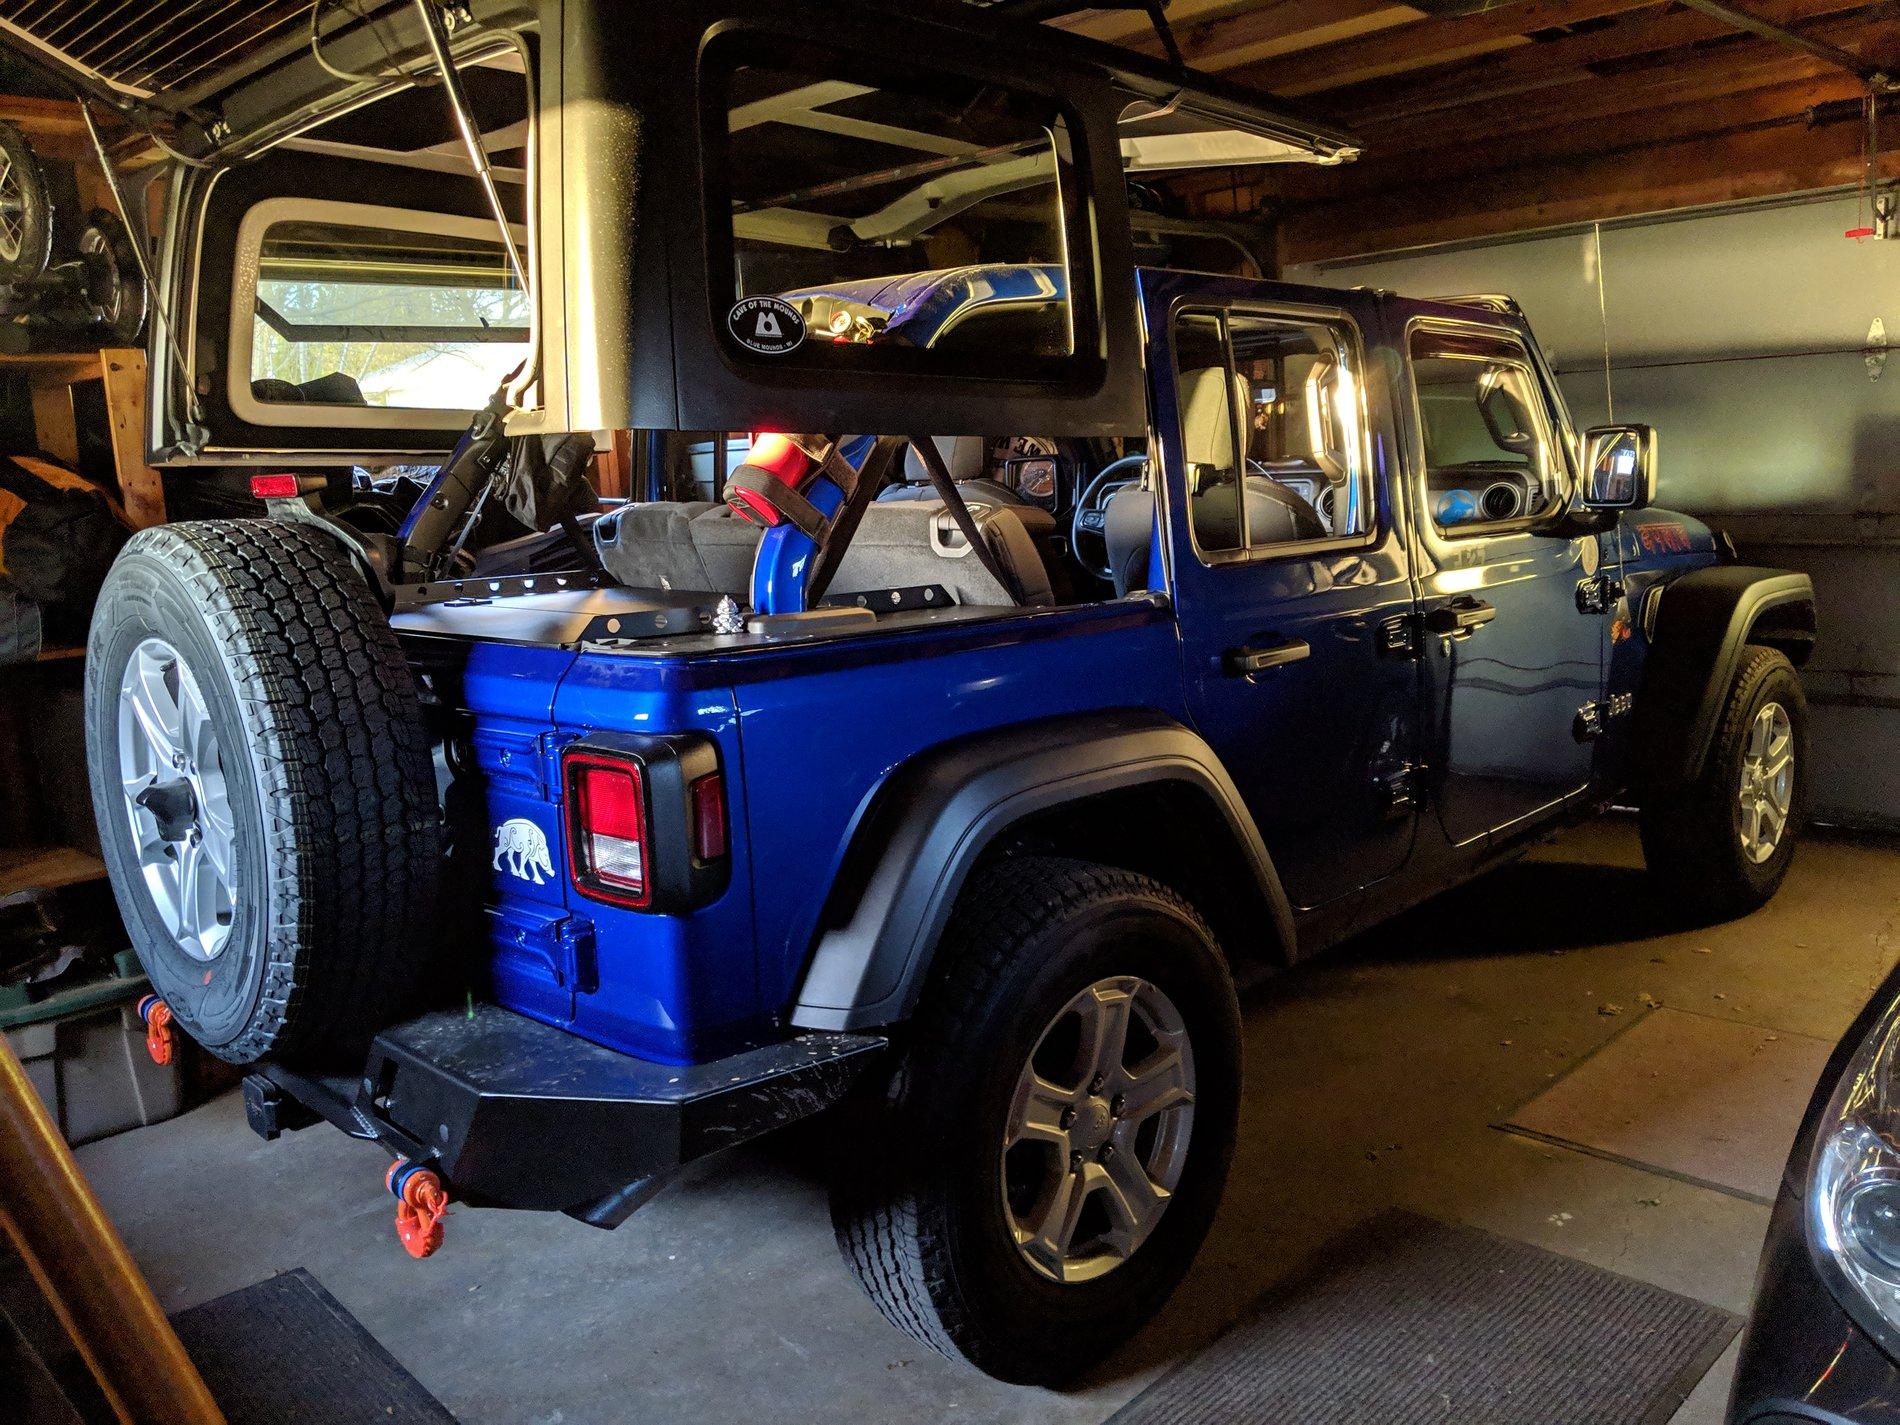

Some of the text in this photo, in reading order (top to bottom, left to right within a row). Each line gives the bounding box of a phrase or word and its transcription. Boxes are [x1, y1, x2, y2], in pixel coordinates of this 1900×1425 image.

[733, 300, 799, 324] CAVE OF THE MOUNDS
[746, 339, 760, 348] BLUE
